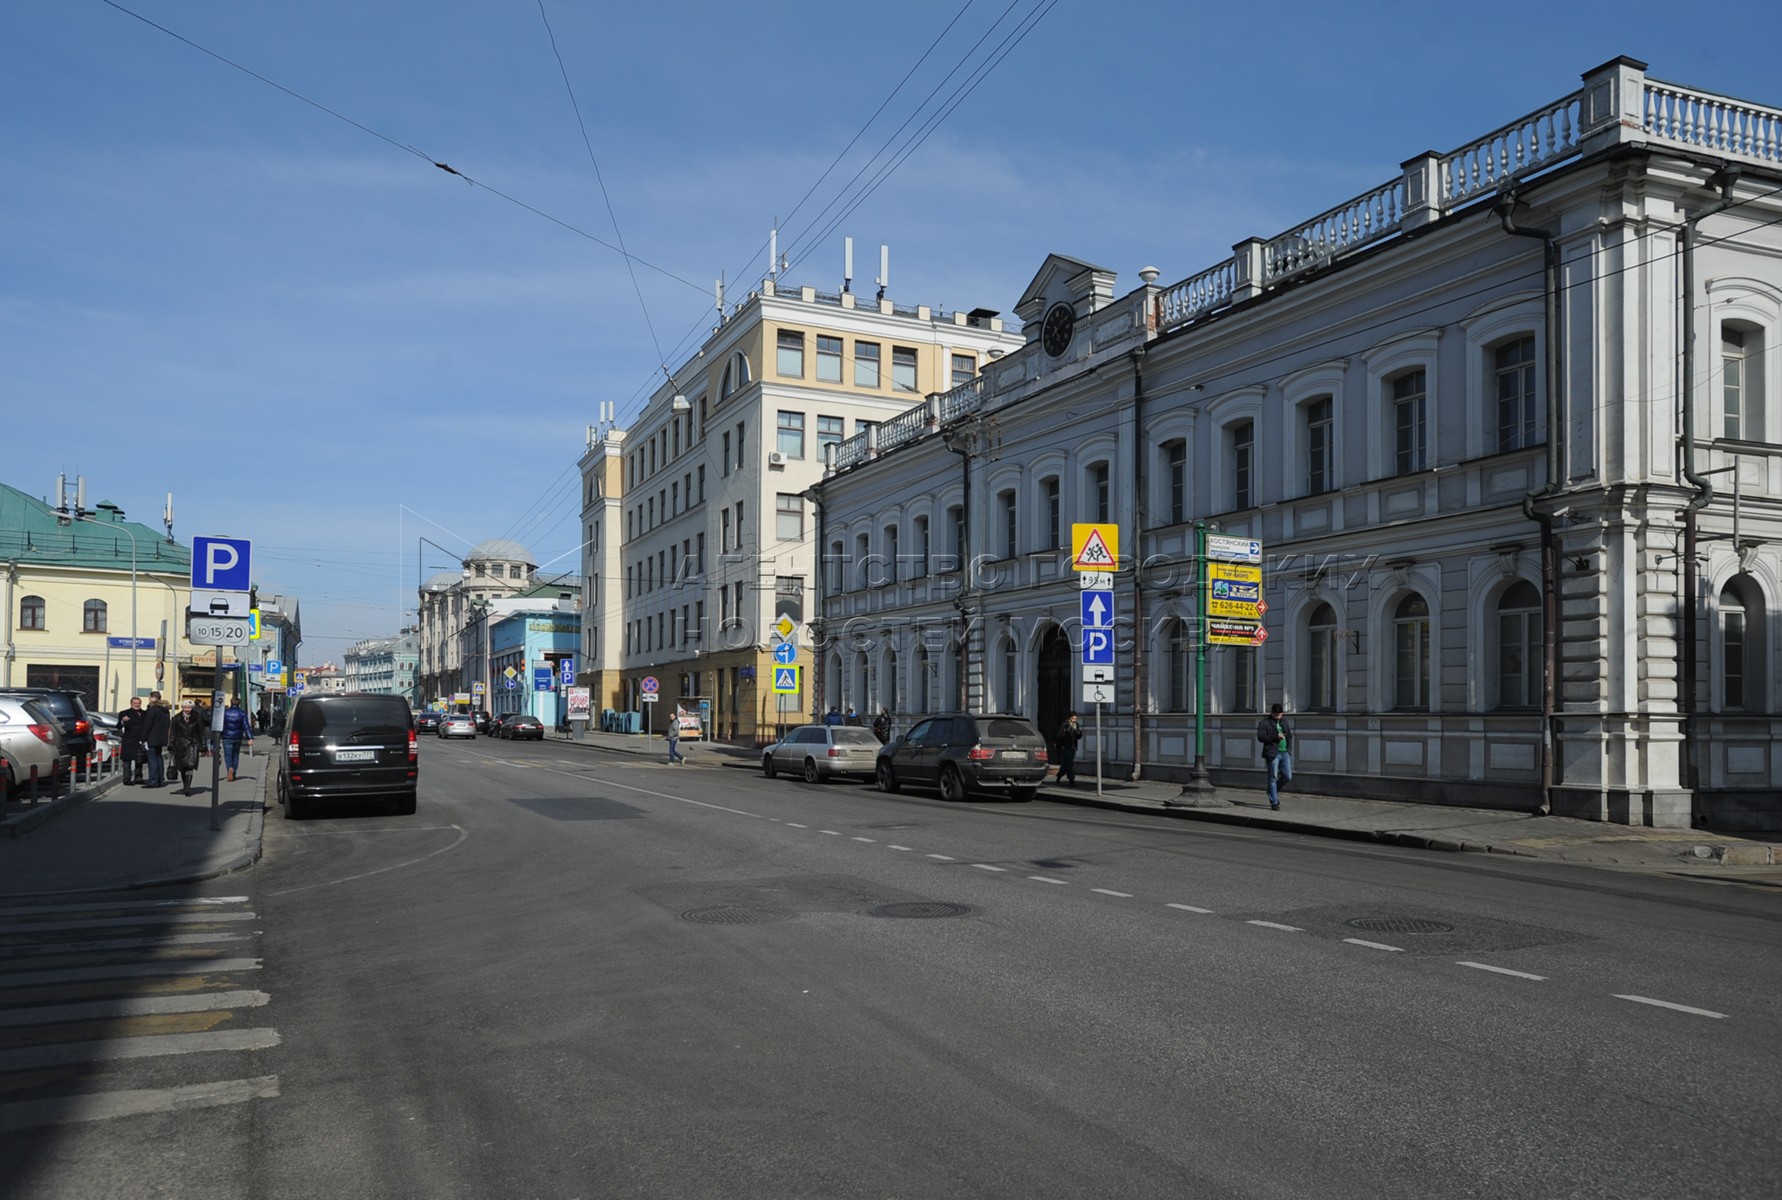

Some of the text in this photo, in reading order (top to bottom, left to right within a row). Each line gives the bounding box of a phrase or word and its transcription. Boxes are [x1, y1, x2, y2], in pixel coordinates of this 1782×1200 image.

[206, 542, 239, 584] P
[197, 626, 243, 638] 10 15 20
[1089, 632, 1108, 660] P
[270, 662, 279, 673] P
[564, 673, 572, 683] P
